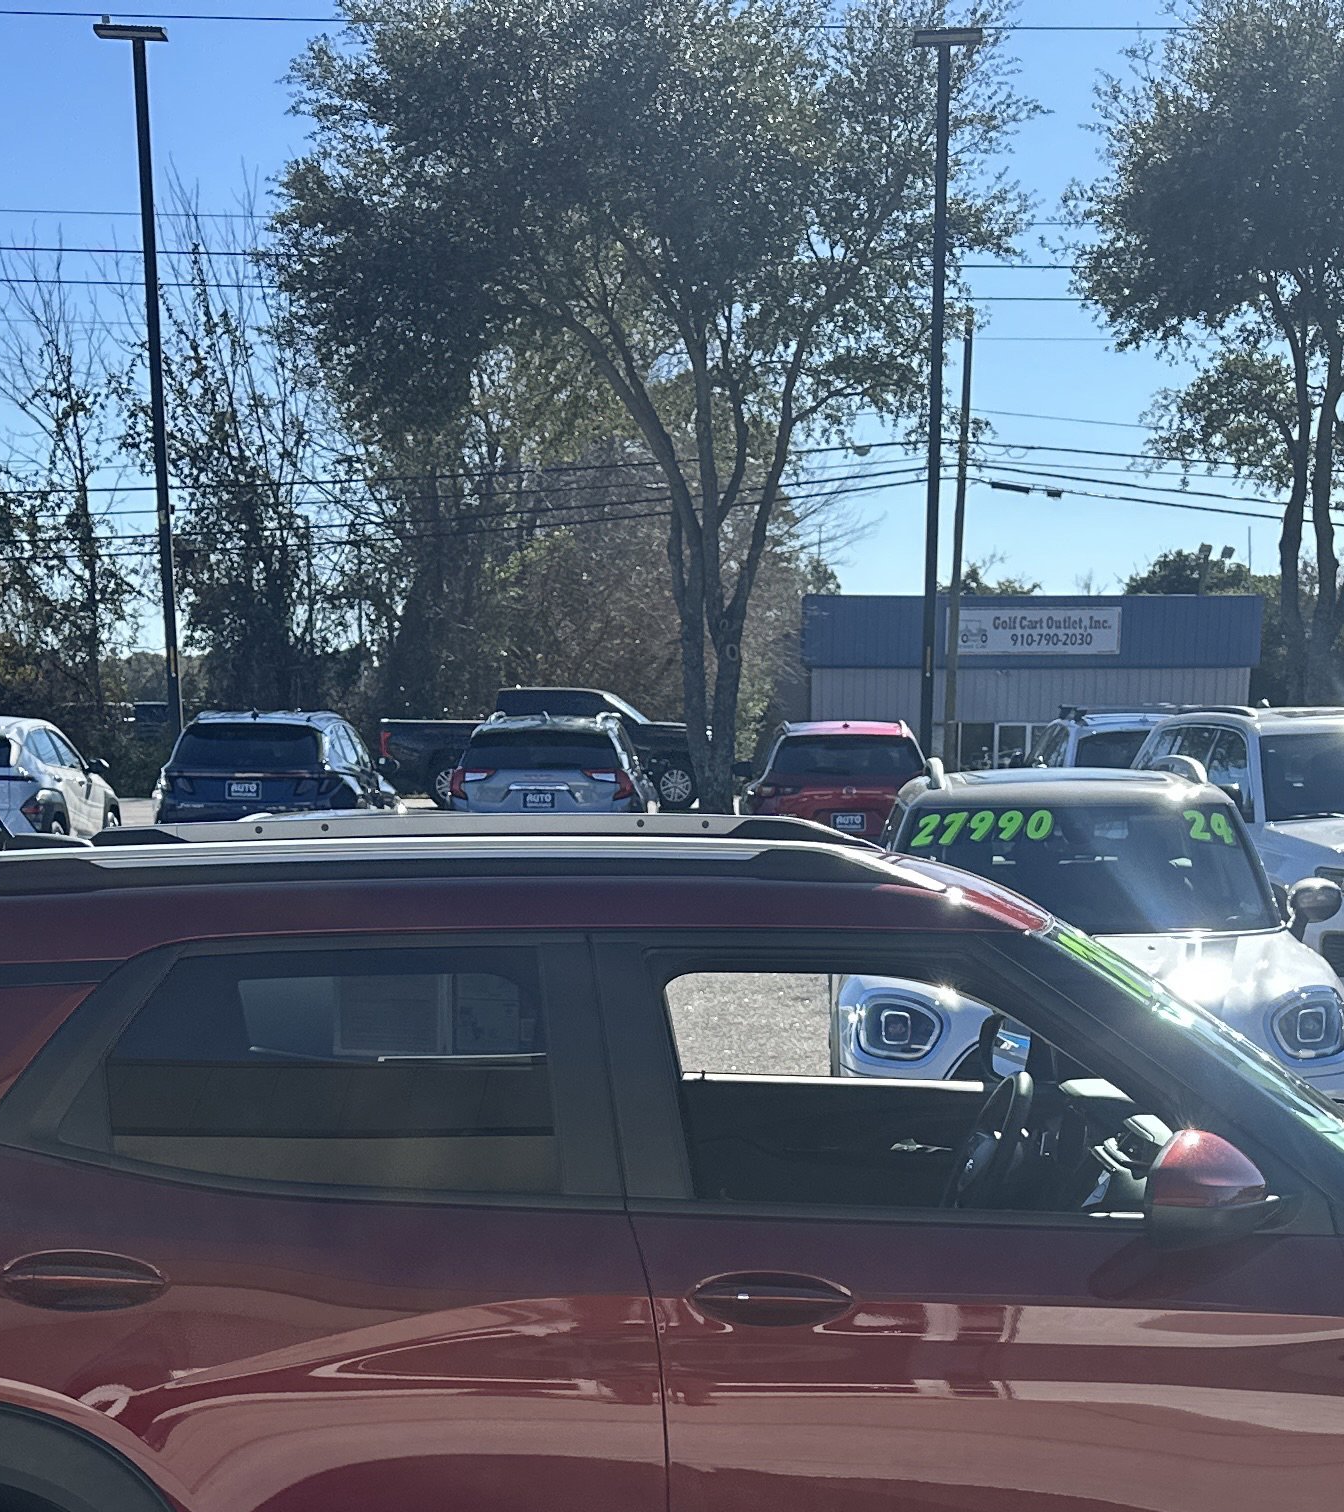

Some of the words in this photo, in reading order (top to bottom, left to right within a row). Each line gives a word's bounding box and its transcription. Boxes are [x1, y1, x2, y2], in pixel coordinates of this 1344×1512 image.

[992, 616, 1017, 630] Golf
[1019, 616, 1044, 630] Cart
[1011, 633, 1093, 646] 910-790-2030
[231, 783, 256, 792] AUTO
[526, 794, 552, 802] AUTO
[836, 815, 862, 824] AUTO
[910, 810, 1053, 847] 27990
[1183, 810, 1236, 845] 24
